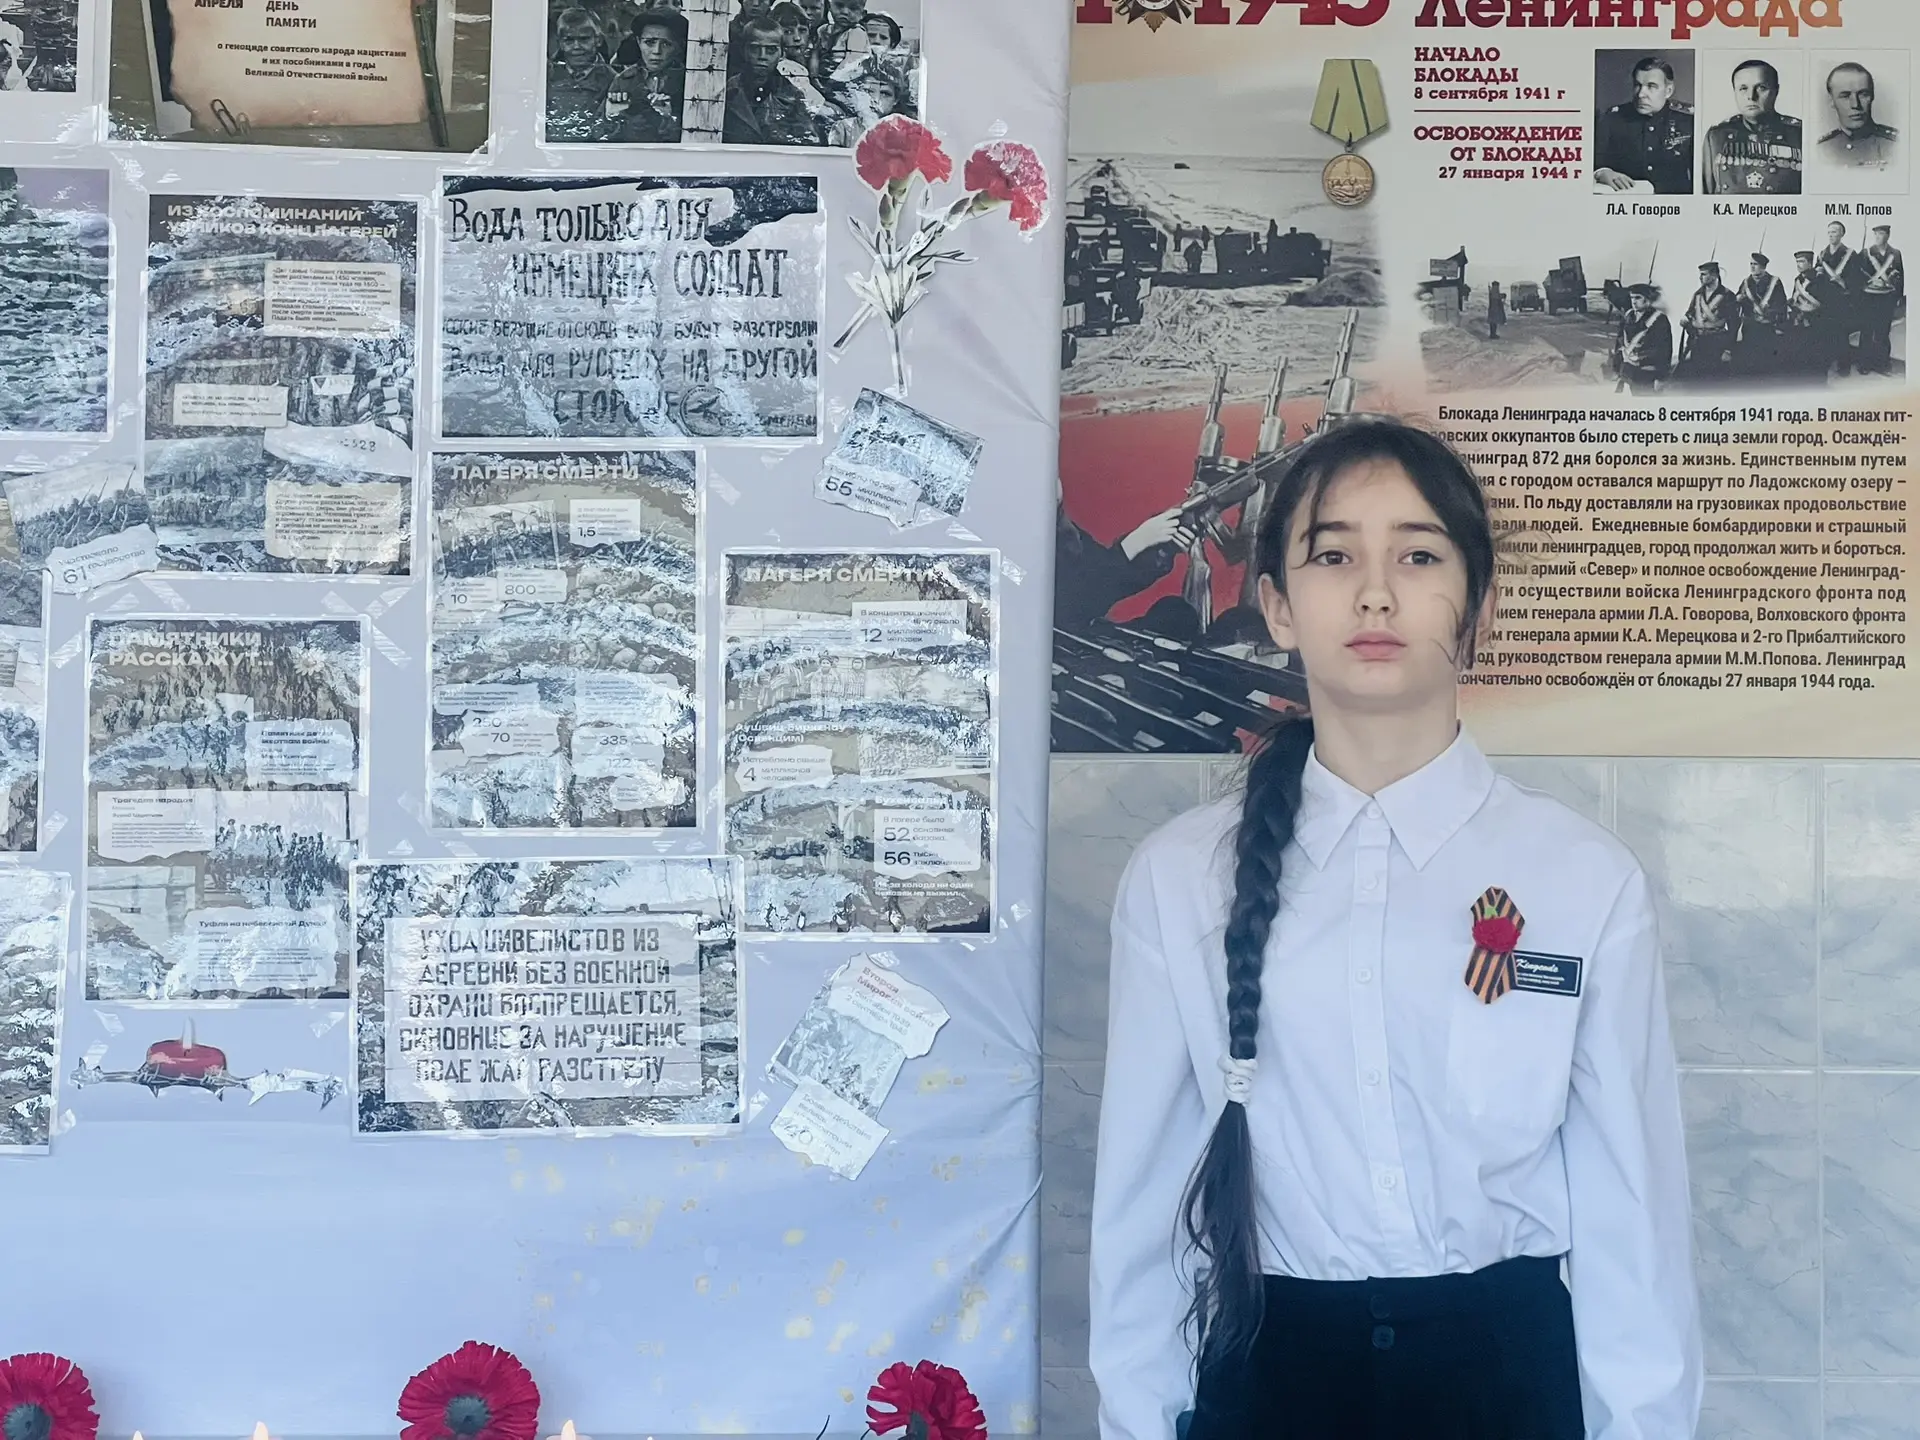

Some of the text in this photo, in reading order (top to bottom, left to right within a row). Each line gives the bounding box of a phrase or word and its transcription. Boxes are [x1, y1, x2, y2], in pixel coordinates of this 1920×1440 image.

[266, 1, 298, 12] ДЕНЬ
[266, 17, 316, 28] ПАМЯТИ
[225, 44, 268, 52] геноциде
[322, 48, 355, 56] народа
[1414, 47, 1500, 61] НАЧАЛО
[283, 58, 344, 67] пособниками
[353, 62, 375, 70] годы
[245, 68, 387, 81] Великой Отечественной войны
[1414, 68, 1518, 85] БЛОКАДЫ
[1414, 87, 1423, 99] 8
[1429, 87, 1508, 102] сентября
[1515, 88, 1550, 99] 1941
[1414, 126, 1582, 143] ОСВОБОЖДЕНИЕ
[1450, 147, 1582, 163] ОТ БЛОКАДЫ
[1439, 167, 1456, 178] 27
[1463, 169, 1524, 181] января
[1532, 167, 1568, 178] 1944
[168, 204, 193, 216] ИЗ
[1606, 204, 1680, 217] Л.А. Говоров
[1713, 204, 1797, 218] К.А. Мерецков
[1825, 204, 1892, 215] М.М. Попов
[674, 249, 788, 298] СОЛДАТ
[683, 349, 709, 382] НА
[1439, 406, 1912, 425] Блокада Ленинграда началась 8 сентября 1941 года. планах гит-
[1492, 432, 1575, 446] оккупантов
[1579, 428, 1617, 443] было
[1622, 433, 1678, 447] стереть
[1693, 433, 1728, 446] лица
[1733, 433, 1777, 443] земли
[1782, 433, 1827, 447] город.
[1832, 430, 1906, 447] Осаждён-
[1533, 451, 1559, 464] 872
[1563, 455, 1590, 467] дня
[1596, 451, 1656, 468] боролся
[1682, 455, 1735, 465] жизнь.
[1741, 452, 1856, 468] Единственным
[1861, 456, 1906, 470] путем
[451, 464, 638, 480] ЛАГЕРЯ СМЕРТИ
[825, 476, 853, 496] 55
[1511, 476, 1572, 490] городом
[1577, 477, 1652, 487] оставался
[1657, 477, 1723, 491] маршрут
[1749, 474, 1846, 492] Ладожскому
[1851, 478, 1893, 492] озеру
[1524, 495, 1906, 514] По льду доставляли грузовиках продовольствие
[577, 526, 596, 538] 1,5
[1531, 518, 1906, 536] людей. Ежедневные бомбардировки страшный
[1541, 540, 1905, 558] ленинградцев, город продолжал жить бороться.
[63, 566, 88, 584] 61
[744, 567, 832, 582] ЛАГЕРЯ
[1531, 561, 1905, 581] армий «Север» полное освобождение Ленинград-
[505, 585, 536, 595] 800
[1519, 584, 1906, 602] осуществили войска Ленинградского фронта под
[1532, 606, 1905, 625] генерала армии Л.А. Говорова, Волховского фронта
[861, 628, 882, 642] 12
[1507, 631, 1570, 645] генерала
[1574, 631, 1618, 645] армии
[1623, 628, 1651, 642] К.А.
[1656, 628, 1737, 646] Мерецкова
[1753, 629, 1782, 643] 2-го
[1787, 629, 1905, 647] Прибалтийского
[1499, 653, 1602, 667] руководством
[1607, 654, 1671, 668] генерала
[1676, 654, 1721, 668] армии
[1726, 651, 1821, 665] М.М.Попова.
[1826, 652, 1905, 669] Ленинград
[1546, 671, 1634, 689] освобождён
[1658, 672, 1721, 689] блокады
[1726, 673, 1742, 687] 27
[1747, 677, 1796, 691] января
[1801, 674, 1834, 687] 1944
[1839, 678, 1874, 690] года.
[490, 732, 511, 743] 70
[600, 735, 628, 745] 335
[743, 767, 756, 781] 4
[884, 827, 910, 841] 52
[884, 851, 911, 865] 56
[633, 928, 660, 951] ИЗ
[419, 961, 518, 985] ДЕРЕВНИ
[526, 960, 567, 985] БЕЗ
